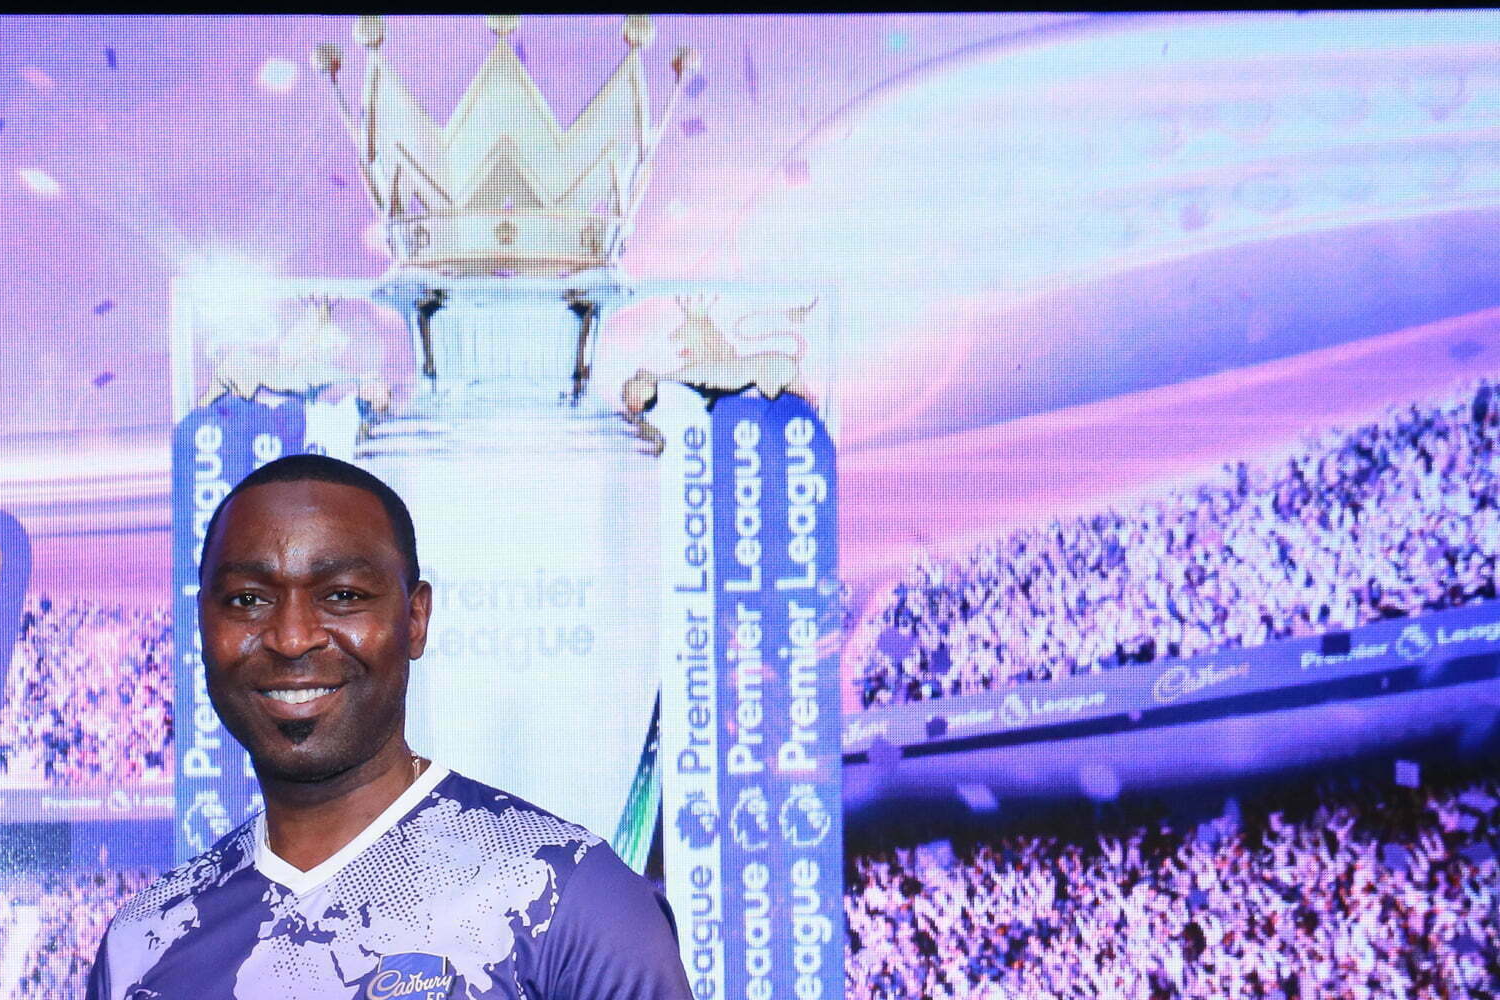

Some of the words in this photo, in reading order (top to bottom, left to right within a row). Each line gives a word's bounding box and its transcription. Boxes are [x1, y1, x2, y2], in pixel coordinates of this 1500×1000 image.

[673, 425, 712, 593] League
[774, 416, 829, 591] League
[422, 622, 594, 674] eague
[676, 609, 711, 775] Premier
[726, 603, 764, 775] Premier
[776, 600, 820, 772] Premier
[367, 969, 452, 1000] Cadbury
